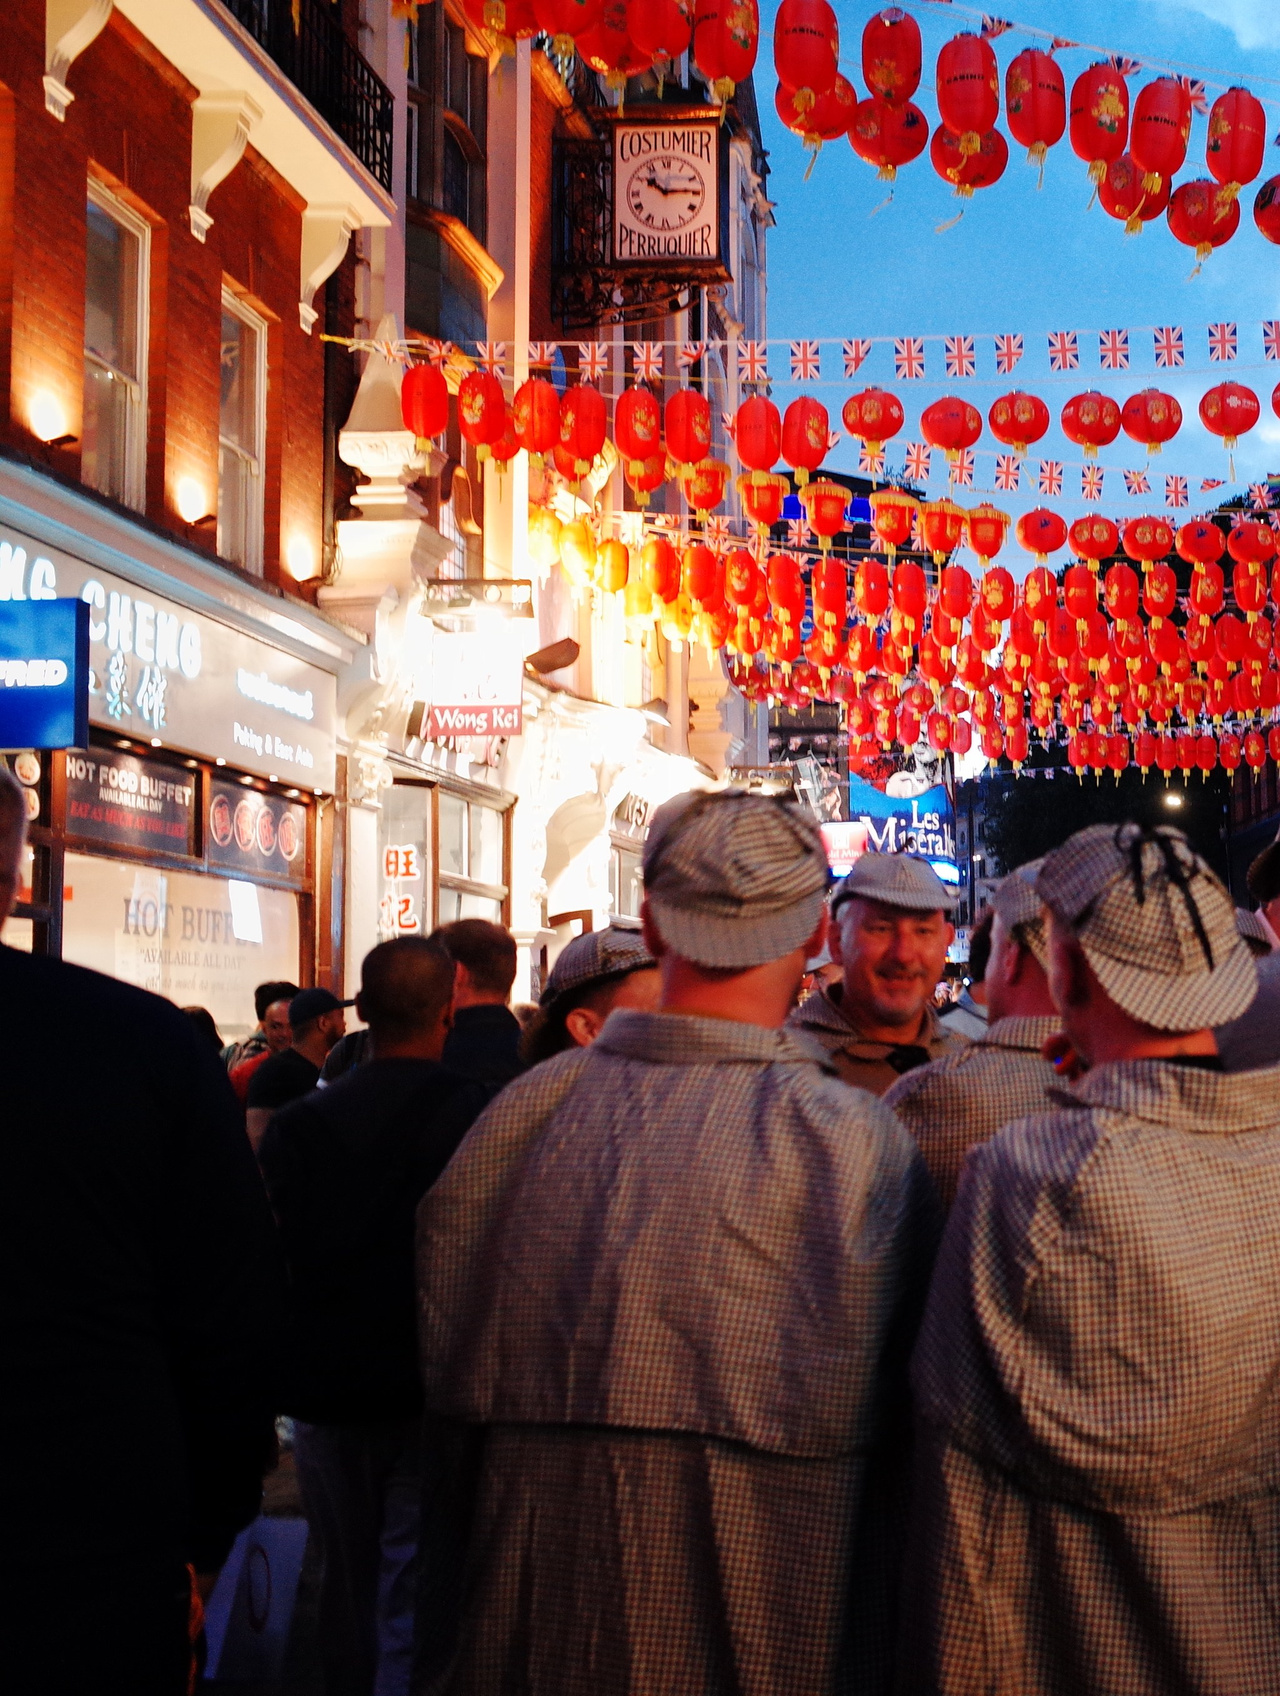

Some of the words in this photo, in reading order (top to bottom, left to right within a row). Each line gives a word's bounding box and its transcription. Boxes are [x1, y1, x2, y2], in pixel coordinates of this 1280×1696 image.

[619, 129, 712, 164] COSTUMIER
[618, 222, 712, 258] PERRUQUIER
[433, 707, 489, 734] Wong
[491, 707, 519, 729] Kei
[65, 754, 96, 783] HOT
[99, 764, 139, 794] FOOD
[140, 775, 192, 807] BUFFET
[911, 800, 940, 831] Les
[122, 898, 174, 939] HOT
[203, 952, 221, 968] ALL
